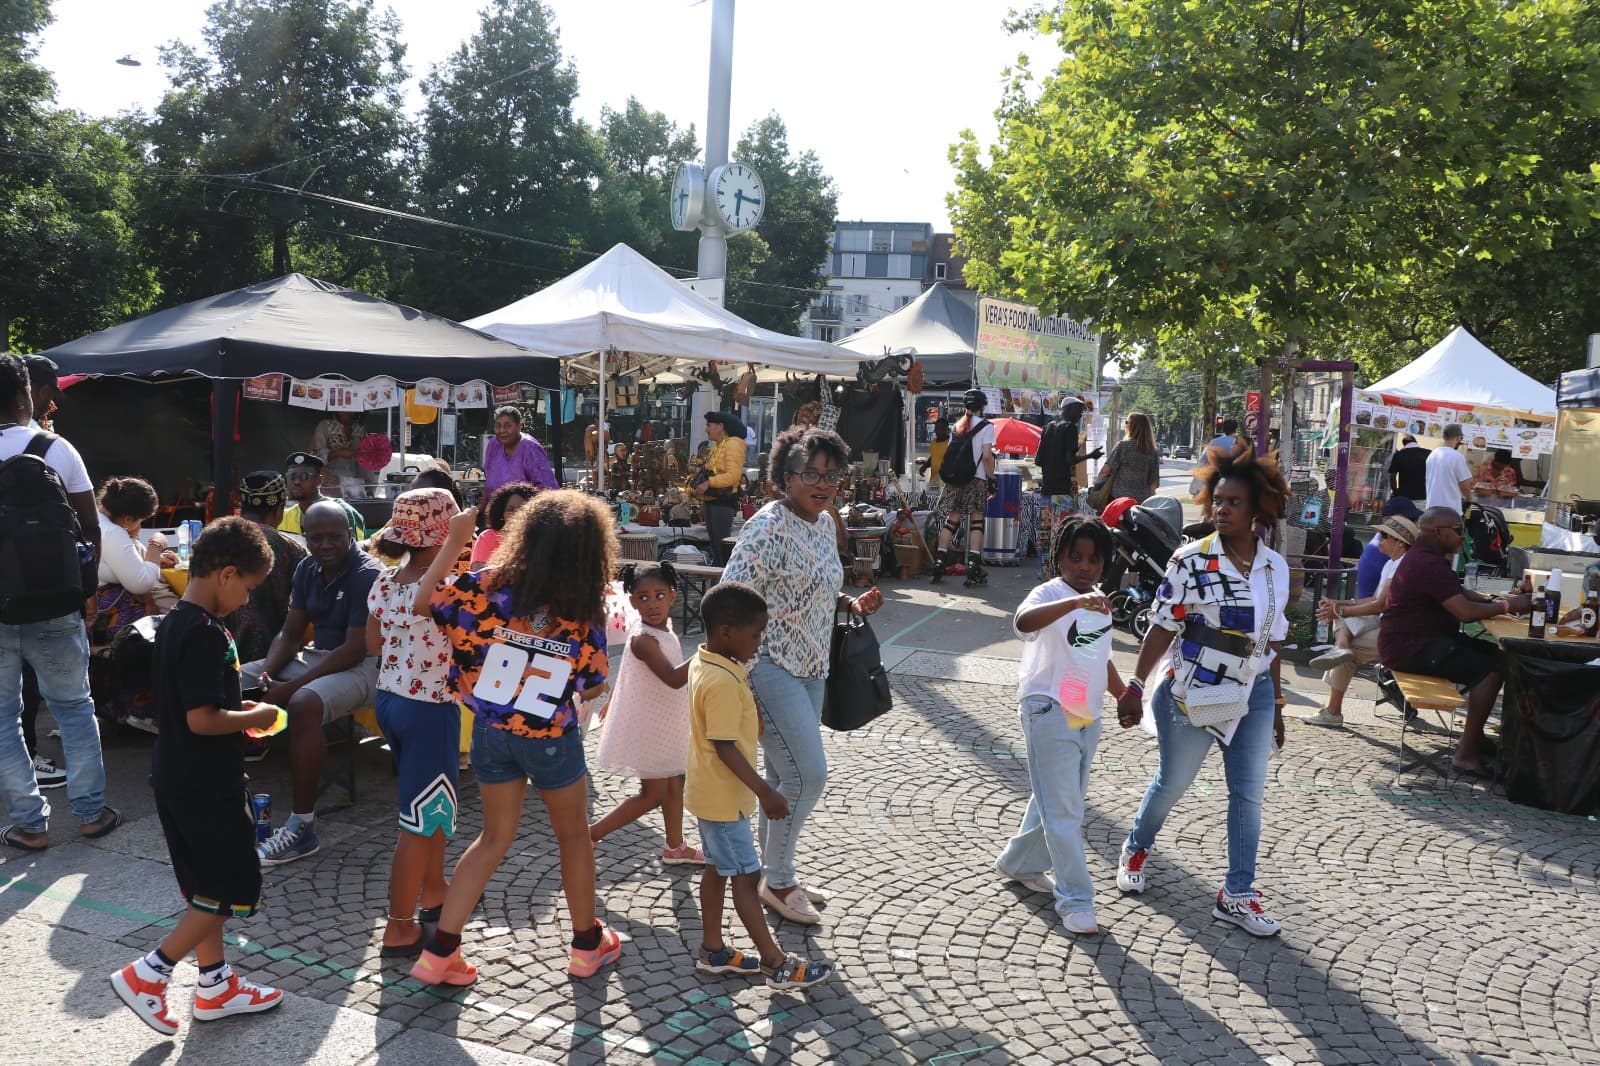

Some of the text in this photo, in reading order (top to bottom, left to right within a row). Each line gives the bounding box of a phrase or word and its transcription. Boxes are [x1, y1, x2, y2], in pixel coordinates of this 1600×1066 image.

[985, 304, 1008, 326] VERA'S
[1009, 308, 1027, 330] FOOD
[1028, 313, 1042, 333] AND
[1043, 316, 1068, 337] VITAMIN
[493, 628, 571, 654] FUTURE IS NOW
[473, 642, 572, 719] 82
